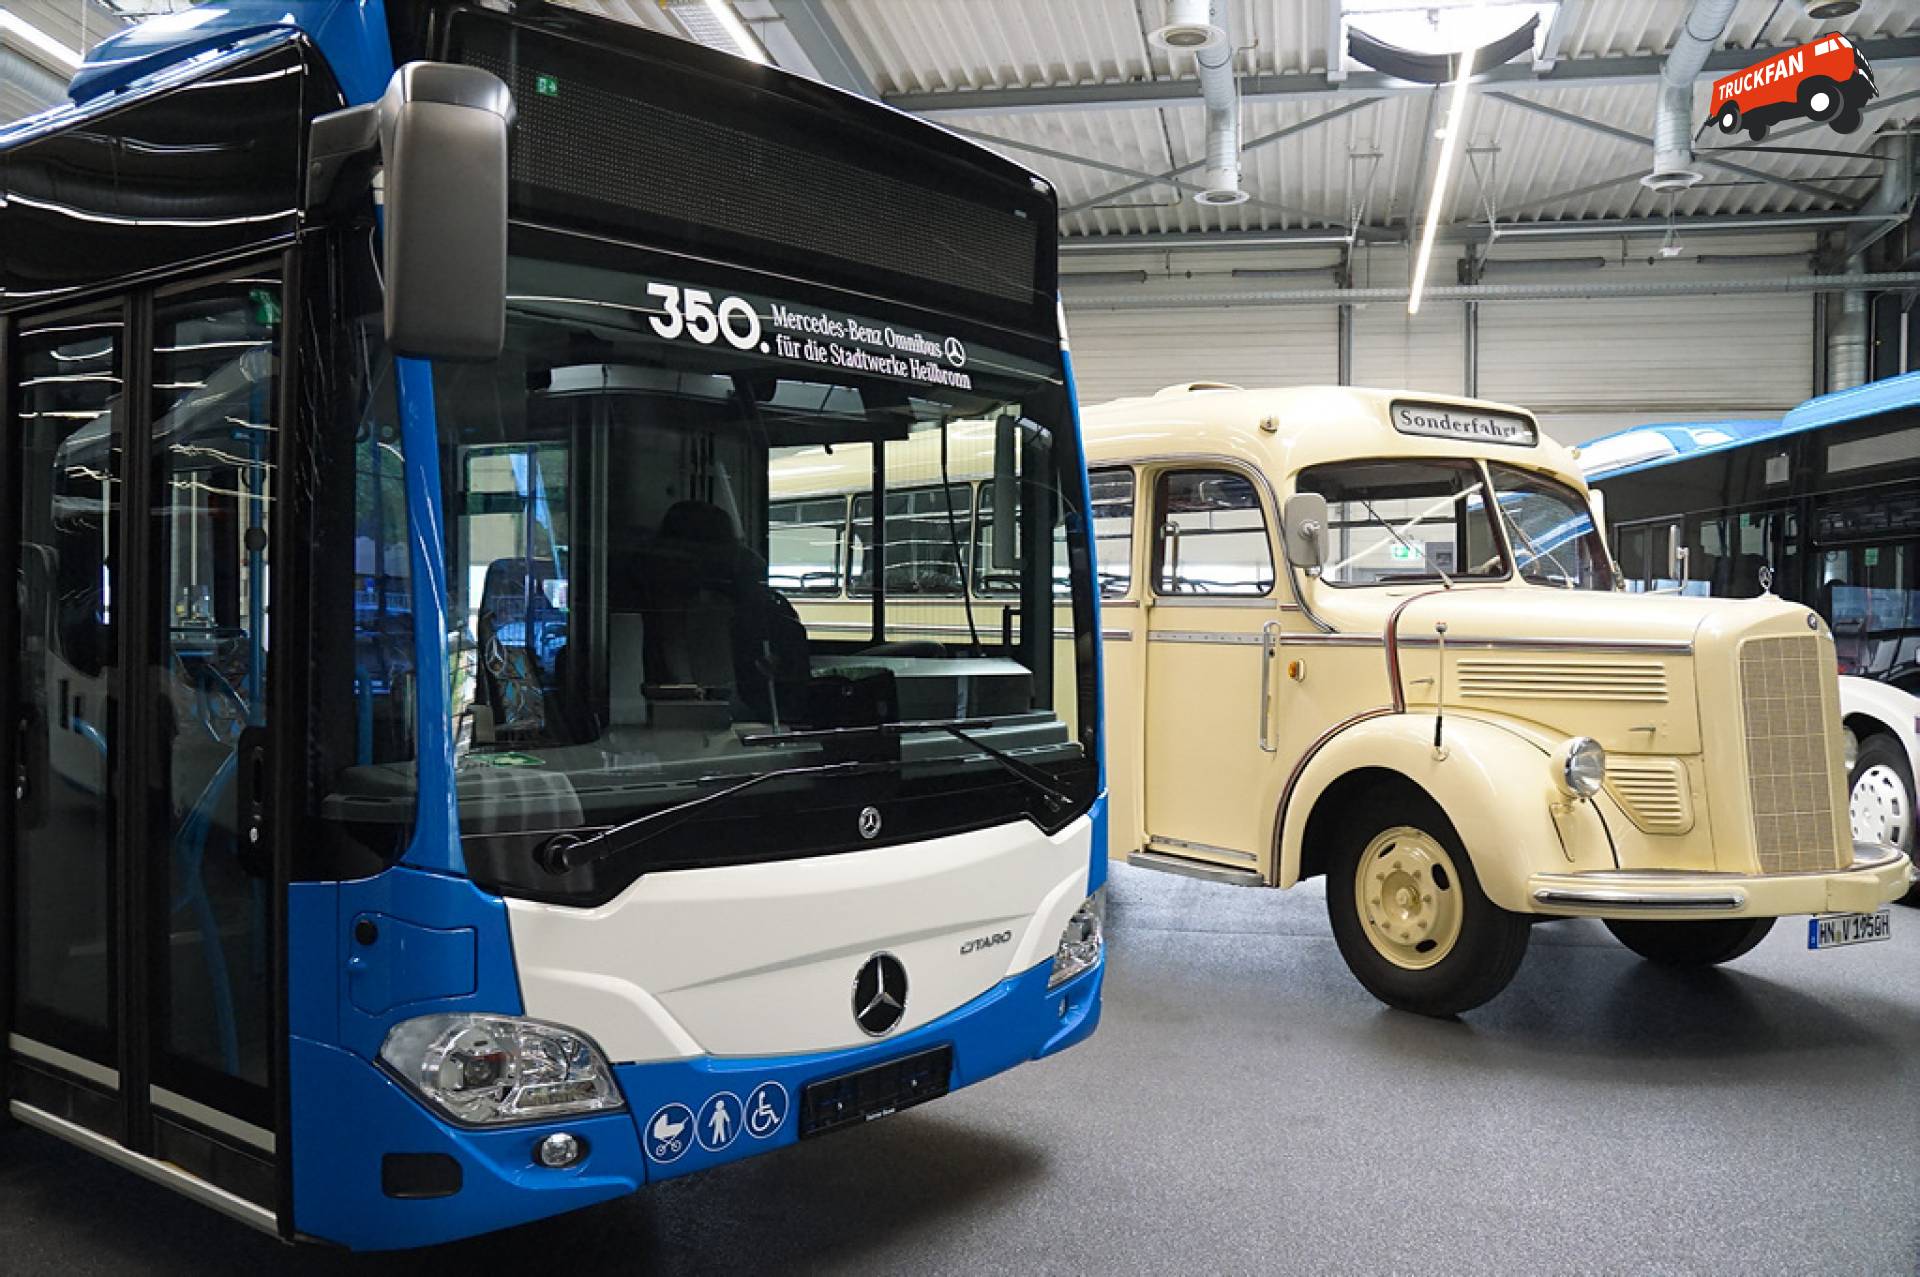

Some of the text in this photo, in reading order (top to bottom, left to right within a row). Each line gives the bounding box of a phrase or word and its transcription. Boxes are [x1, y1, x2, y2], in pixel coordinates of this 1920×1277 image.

[646, 282, 770, 354] 350.
[771, 303, 942, 358] Mercedes-Benz Omnibus
[776, 333, 972, 391] für die Stadtwerke Heilbronn
[960, 930, 1011, 955] CITARO
[1820, 921, 1835, 944] HN
